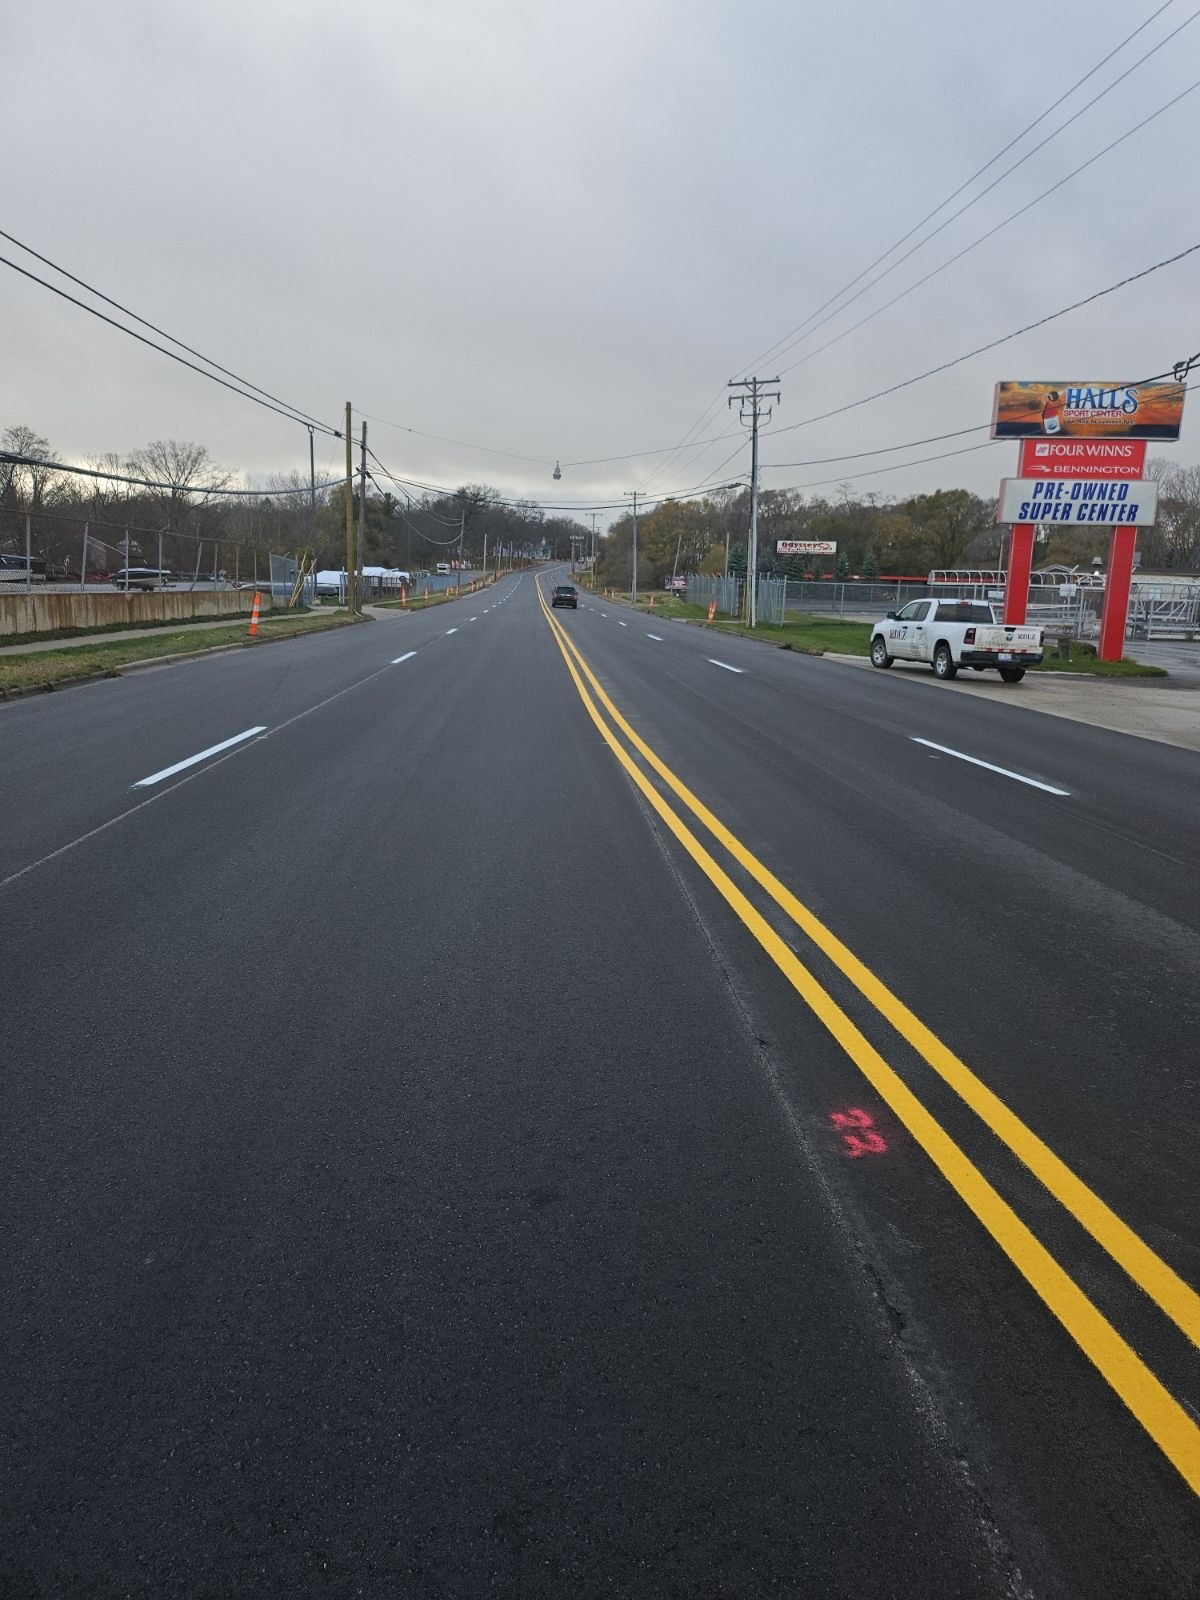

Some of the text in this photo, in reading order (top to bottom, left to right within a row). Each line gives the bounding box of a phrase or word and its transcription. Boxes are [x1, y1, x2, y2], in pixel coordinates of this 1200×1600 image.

[1049, 445, 1131, 457] FOUR WINNS
[1053, 465, 1140, 474] BENNINGTON
[1032, 481, 1130, 501] PRE-OWNED
[1018, 502, 1139, 522] SUPER CENTER
